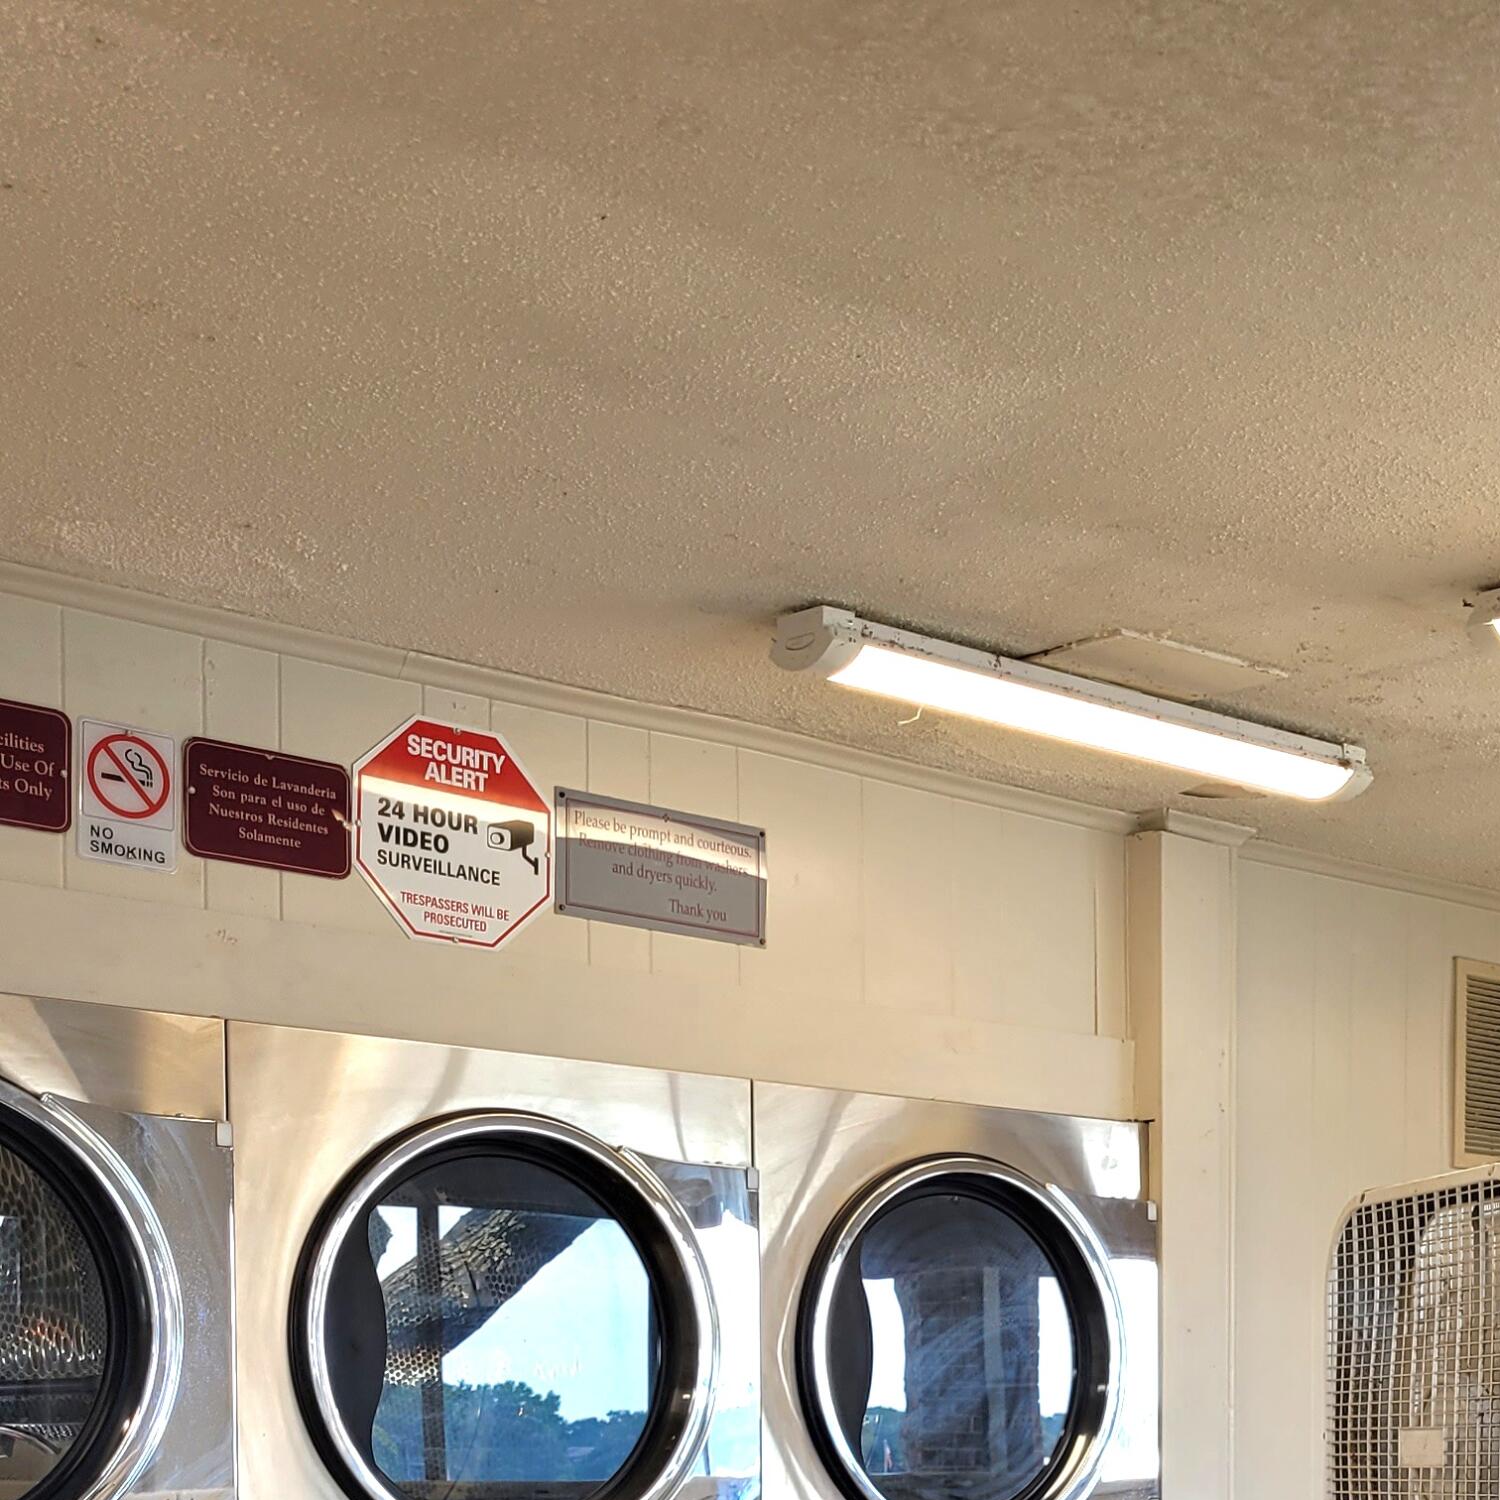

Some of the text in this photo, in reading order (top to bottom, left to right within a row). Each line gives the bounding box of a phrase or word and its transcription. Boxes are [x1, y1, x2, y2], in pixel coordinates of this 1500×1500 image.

[1, 753, 55, 777] Use Of
[407, 734, 505, 774] SECURITY
[14, 778, 53, 801] Only
[199, 763, 249, 783] Servicio
[254, 773, 269, 787] de
[424, 762, 489, 792] ALERT
[212, 785, 325, 816] Son para el uso de
[208, 803, 329, 835] Nuestros Residentes
[377, 797, 478, 835] 24 HOUR
[90, 824, 114, 840] NO
[238, 826, 302, 848] Solamente
[377, 822, 449, 854] VIDEO
[574, 810, 752, 859] Please be prompt and courteous.
[90, 840, 166, 864] SMOKING
[578, 832, 625, 855] Remove
[627, 841, 673, 868] clothing
[676, 850, 702, 868] from
[377, 849, 501, 886] SURVEILLANCE
[612, 862, 717, 895] and dryers quickly.
[400, 891, 510, 921] TRESPASSERS WILL BE
[668, 899, 727, 923] Thank you
[424, 911, 487, 932] PROSECUTED
